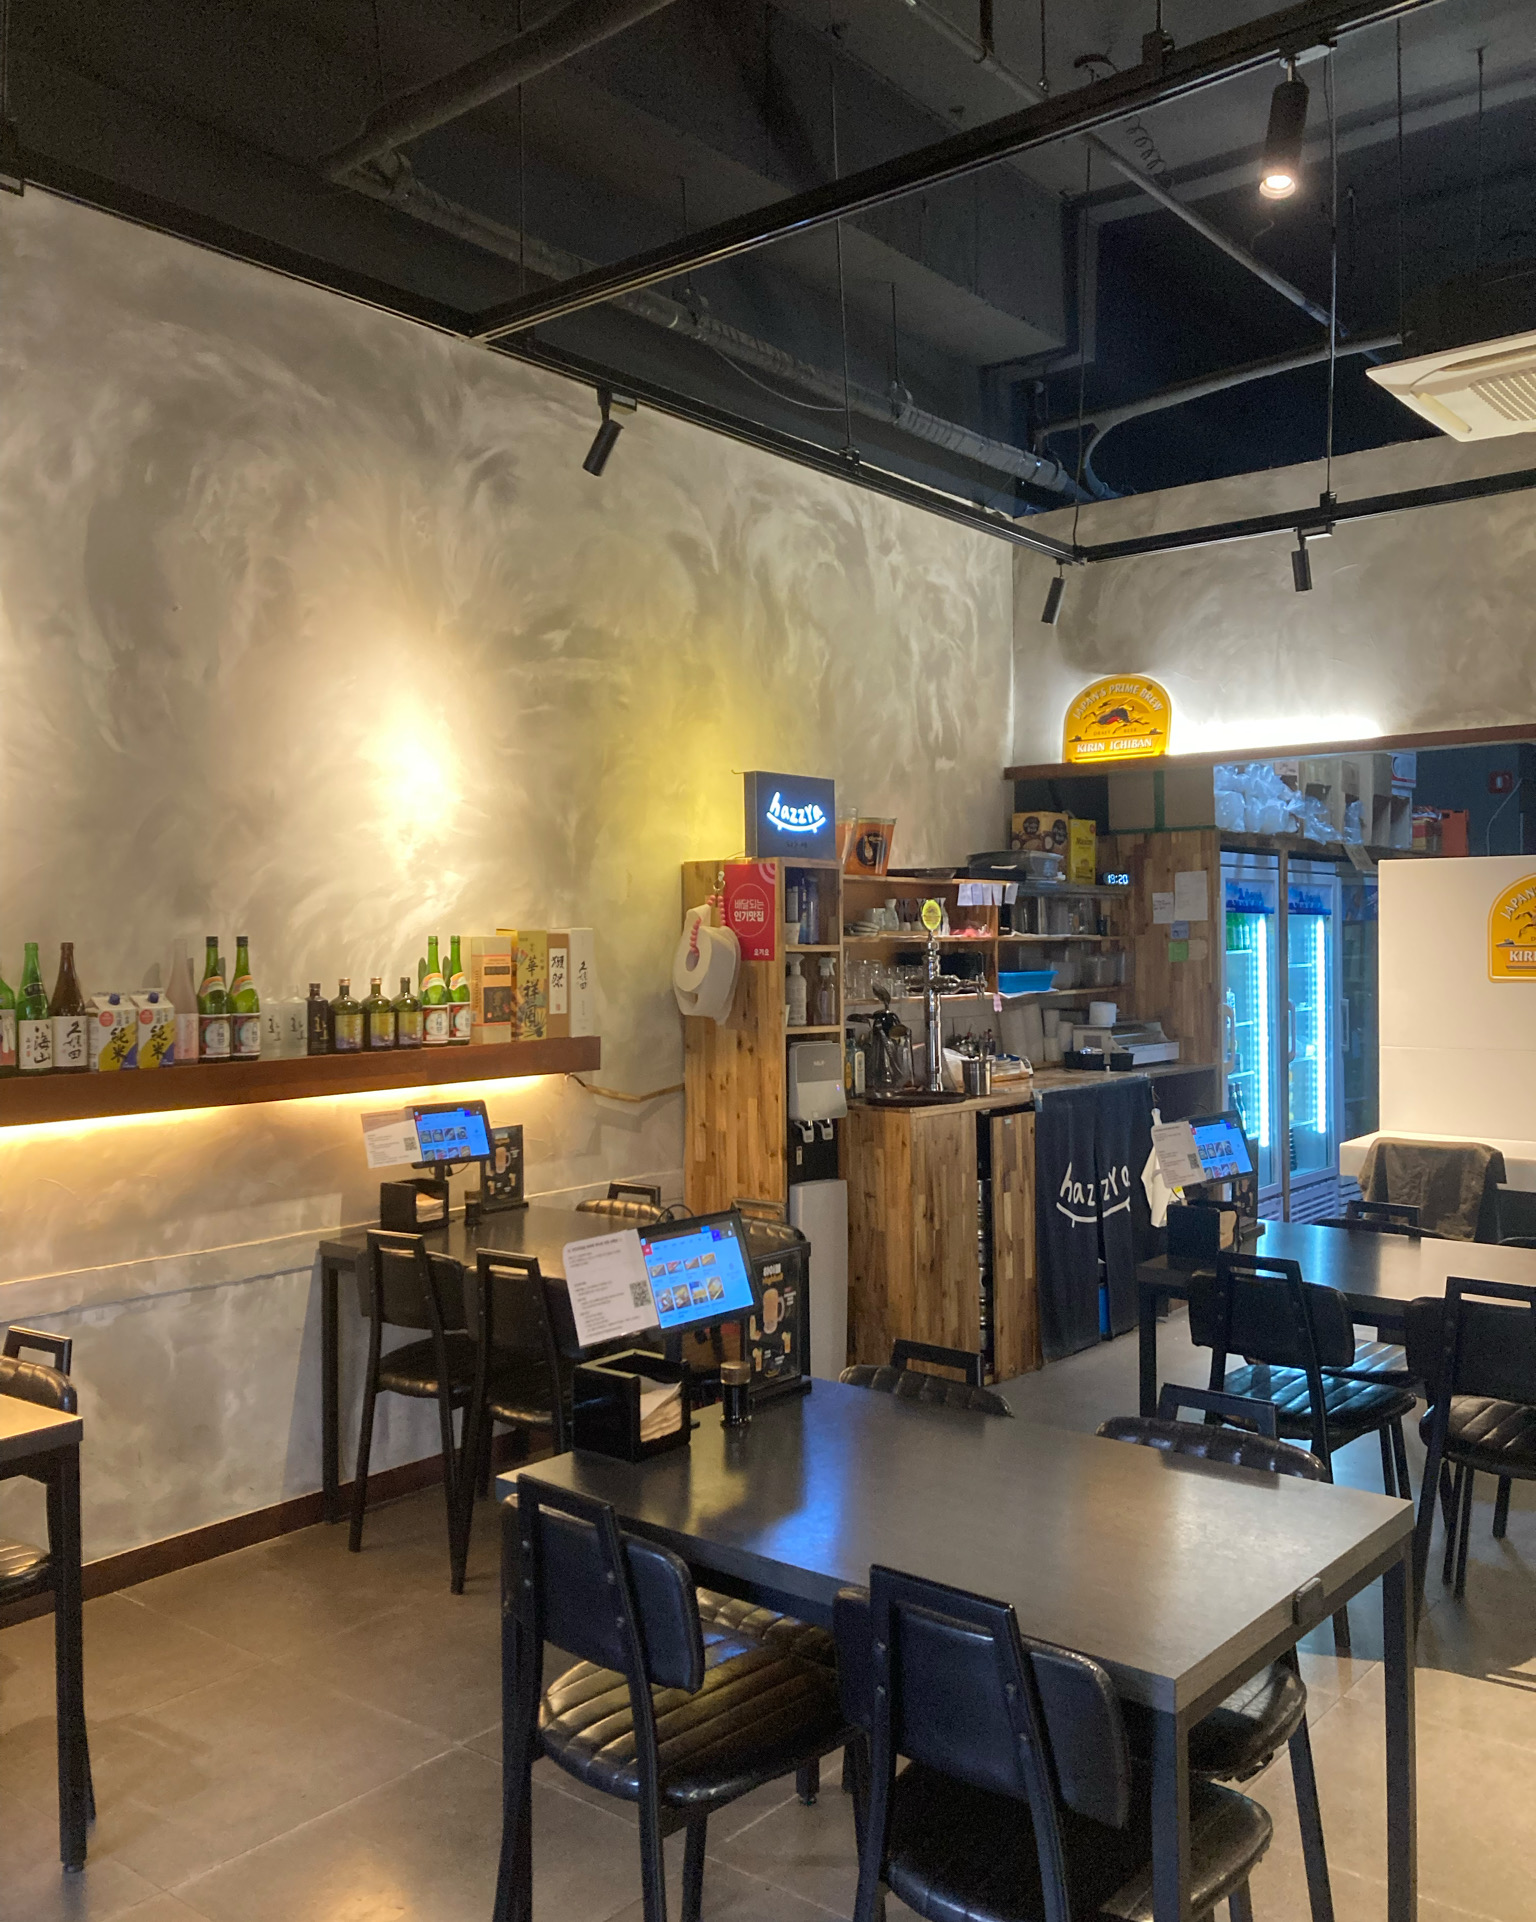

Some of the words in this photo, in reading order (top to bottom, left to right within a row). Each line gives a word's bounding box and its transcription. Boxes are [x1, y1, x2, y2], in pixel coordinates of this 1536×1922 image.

[1073, 687, 1107, 720] JAPAN'S
[1109, 682, 1140, 695] PRIME
[1140, 687, 1164, 712] BREW
[1076, 741, 1105, 753] KIRIN
[1109, 737, 1153, 751] ICHIBAN
[1107, 873, 1129, 885] 19:20
[734, 899, 765, 910] 배달되는
[733, 910, 765, 923] 인기맛집
[753, 948, 770, 956] 요기요
[110, 1027, 129, 1064] 純米
[150, 1024, 168, 1061] 純米
